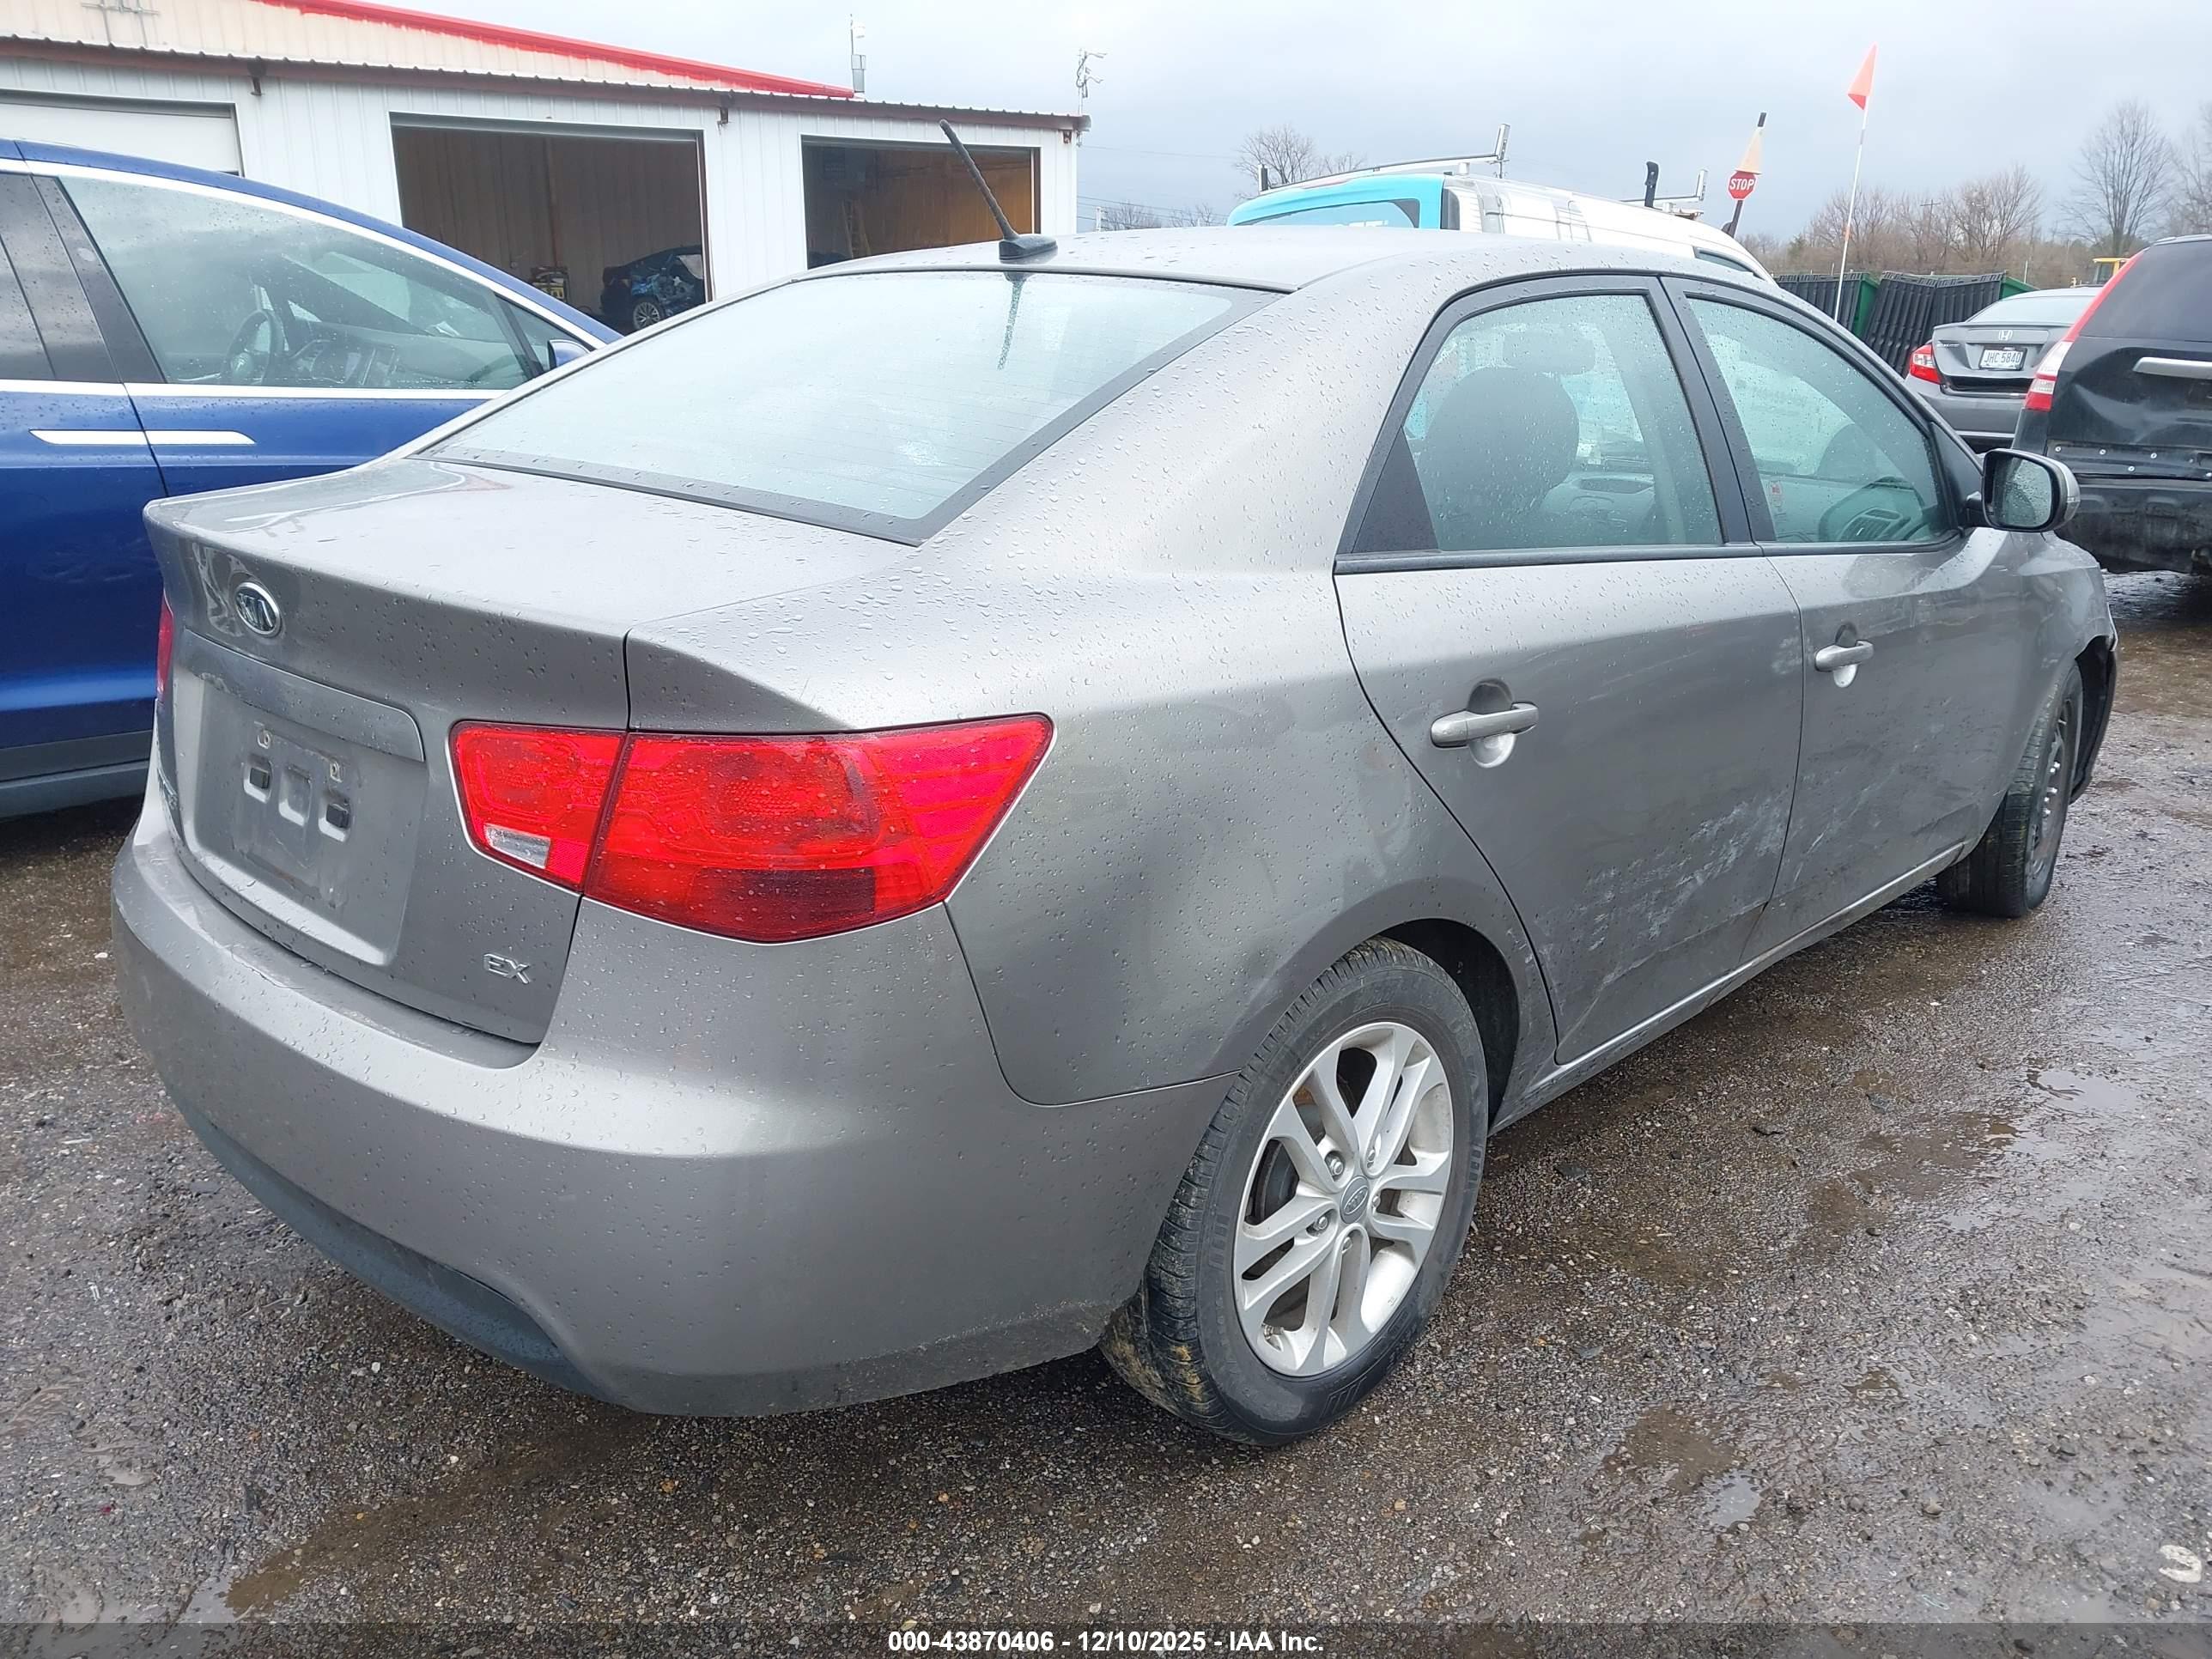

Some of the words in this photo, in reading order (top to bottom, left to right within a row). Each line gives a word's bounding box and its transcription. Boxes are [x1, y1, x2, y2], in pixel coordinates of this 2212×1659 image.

[1729, 178, 1754, 191] STOP
[1984, 352, 2000, 363] JHC
[2001, 352, 2021, 363] 5840
[483, 952, 531, 984] EX
